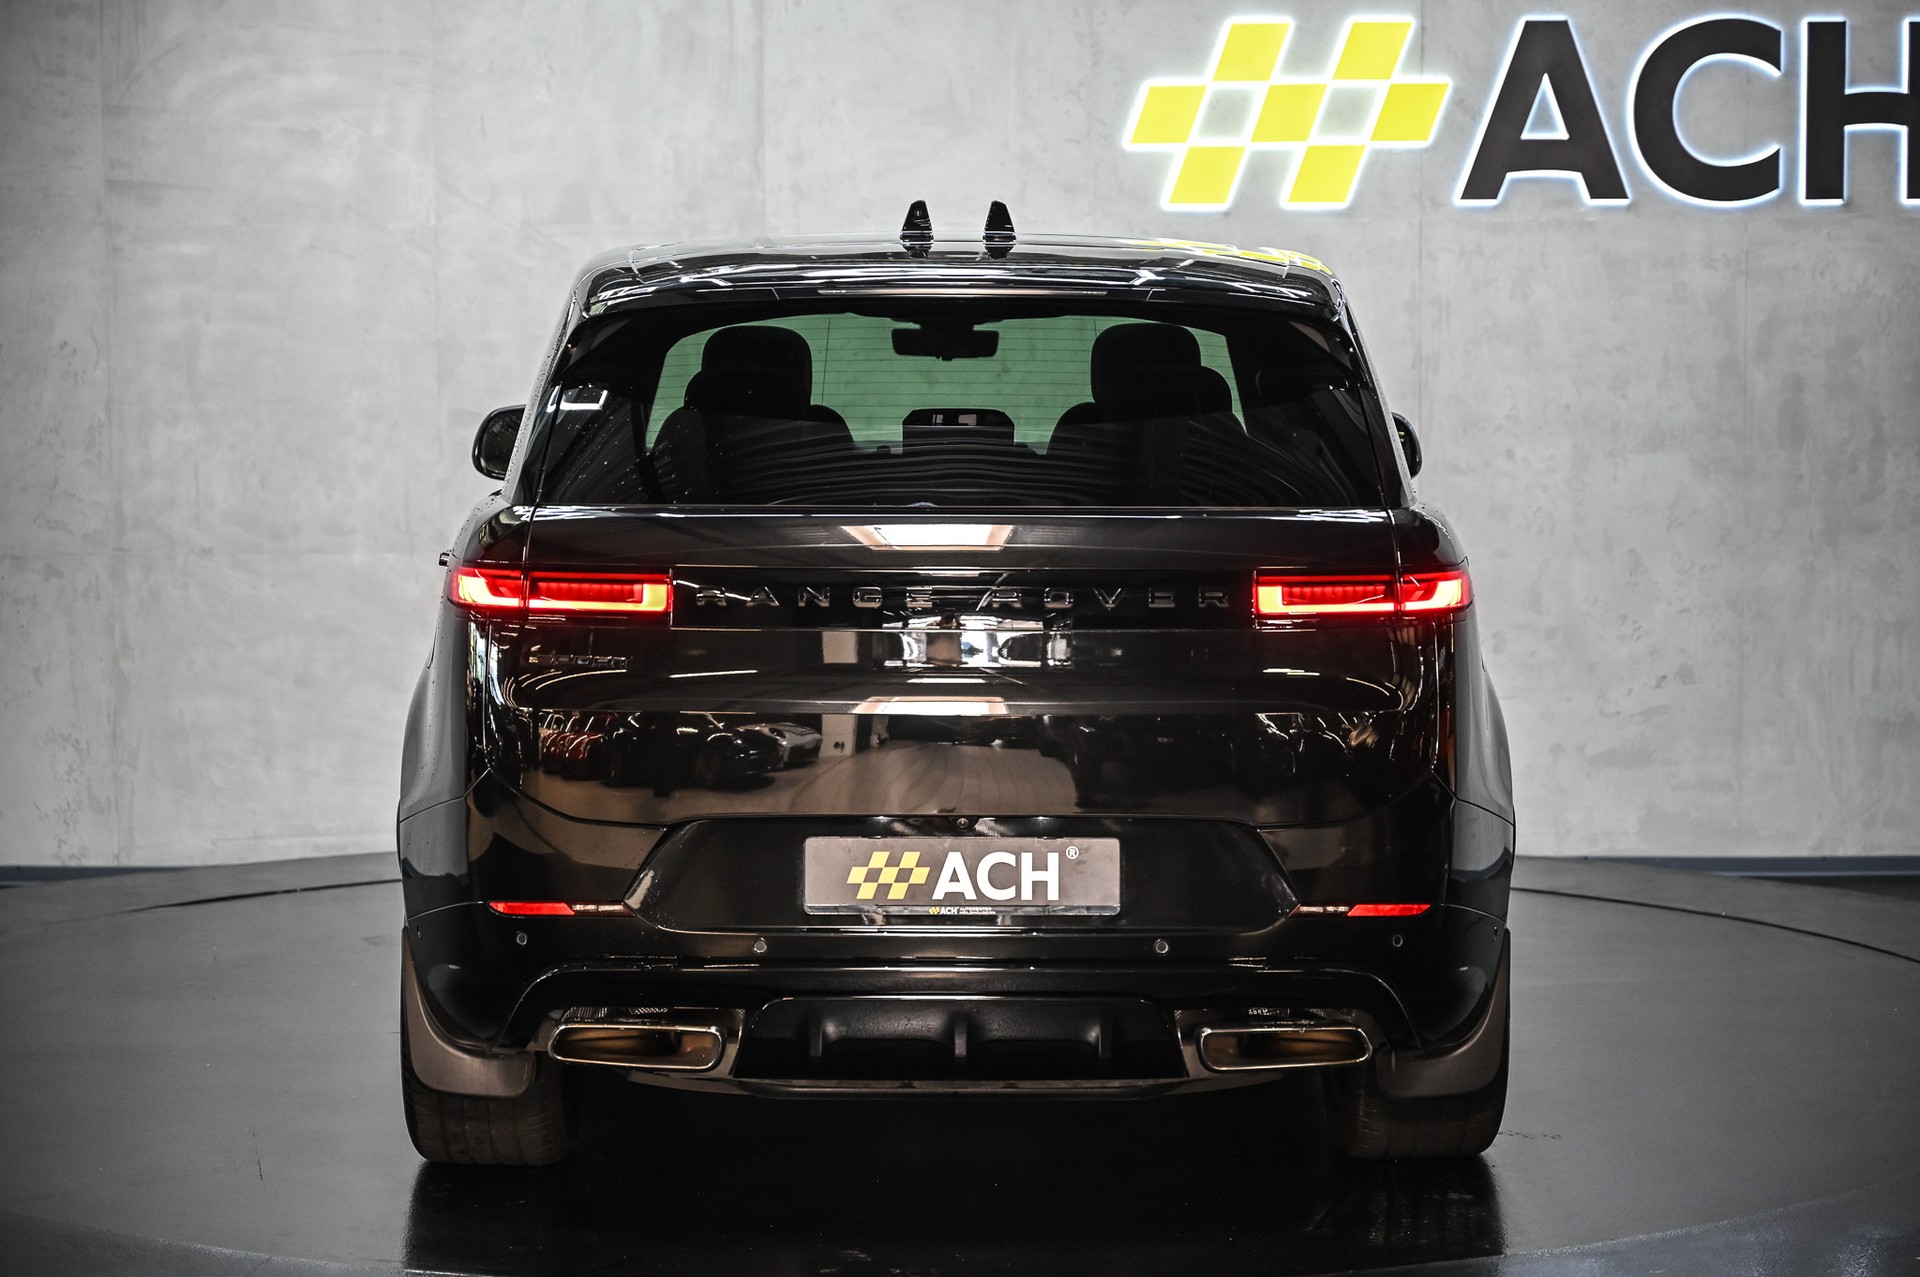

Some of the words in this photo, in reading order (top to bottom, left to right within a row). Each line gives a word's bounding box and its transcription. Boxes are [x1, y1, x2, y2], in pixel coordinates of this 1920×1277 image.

[1458, 16, 1920, 204] ACH
[696, 585, 933, 609] RANGE
[991, 585, 1230, 609] ROVER
[931, 851, 1059, 901] ACH
